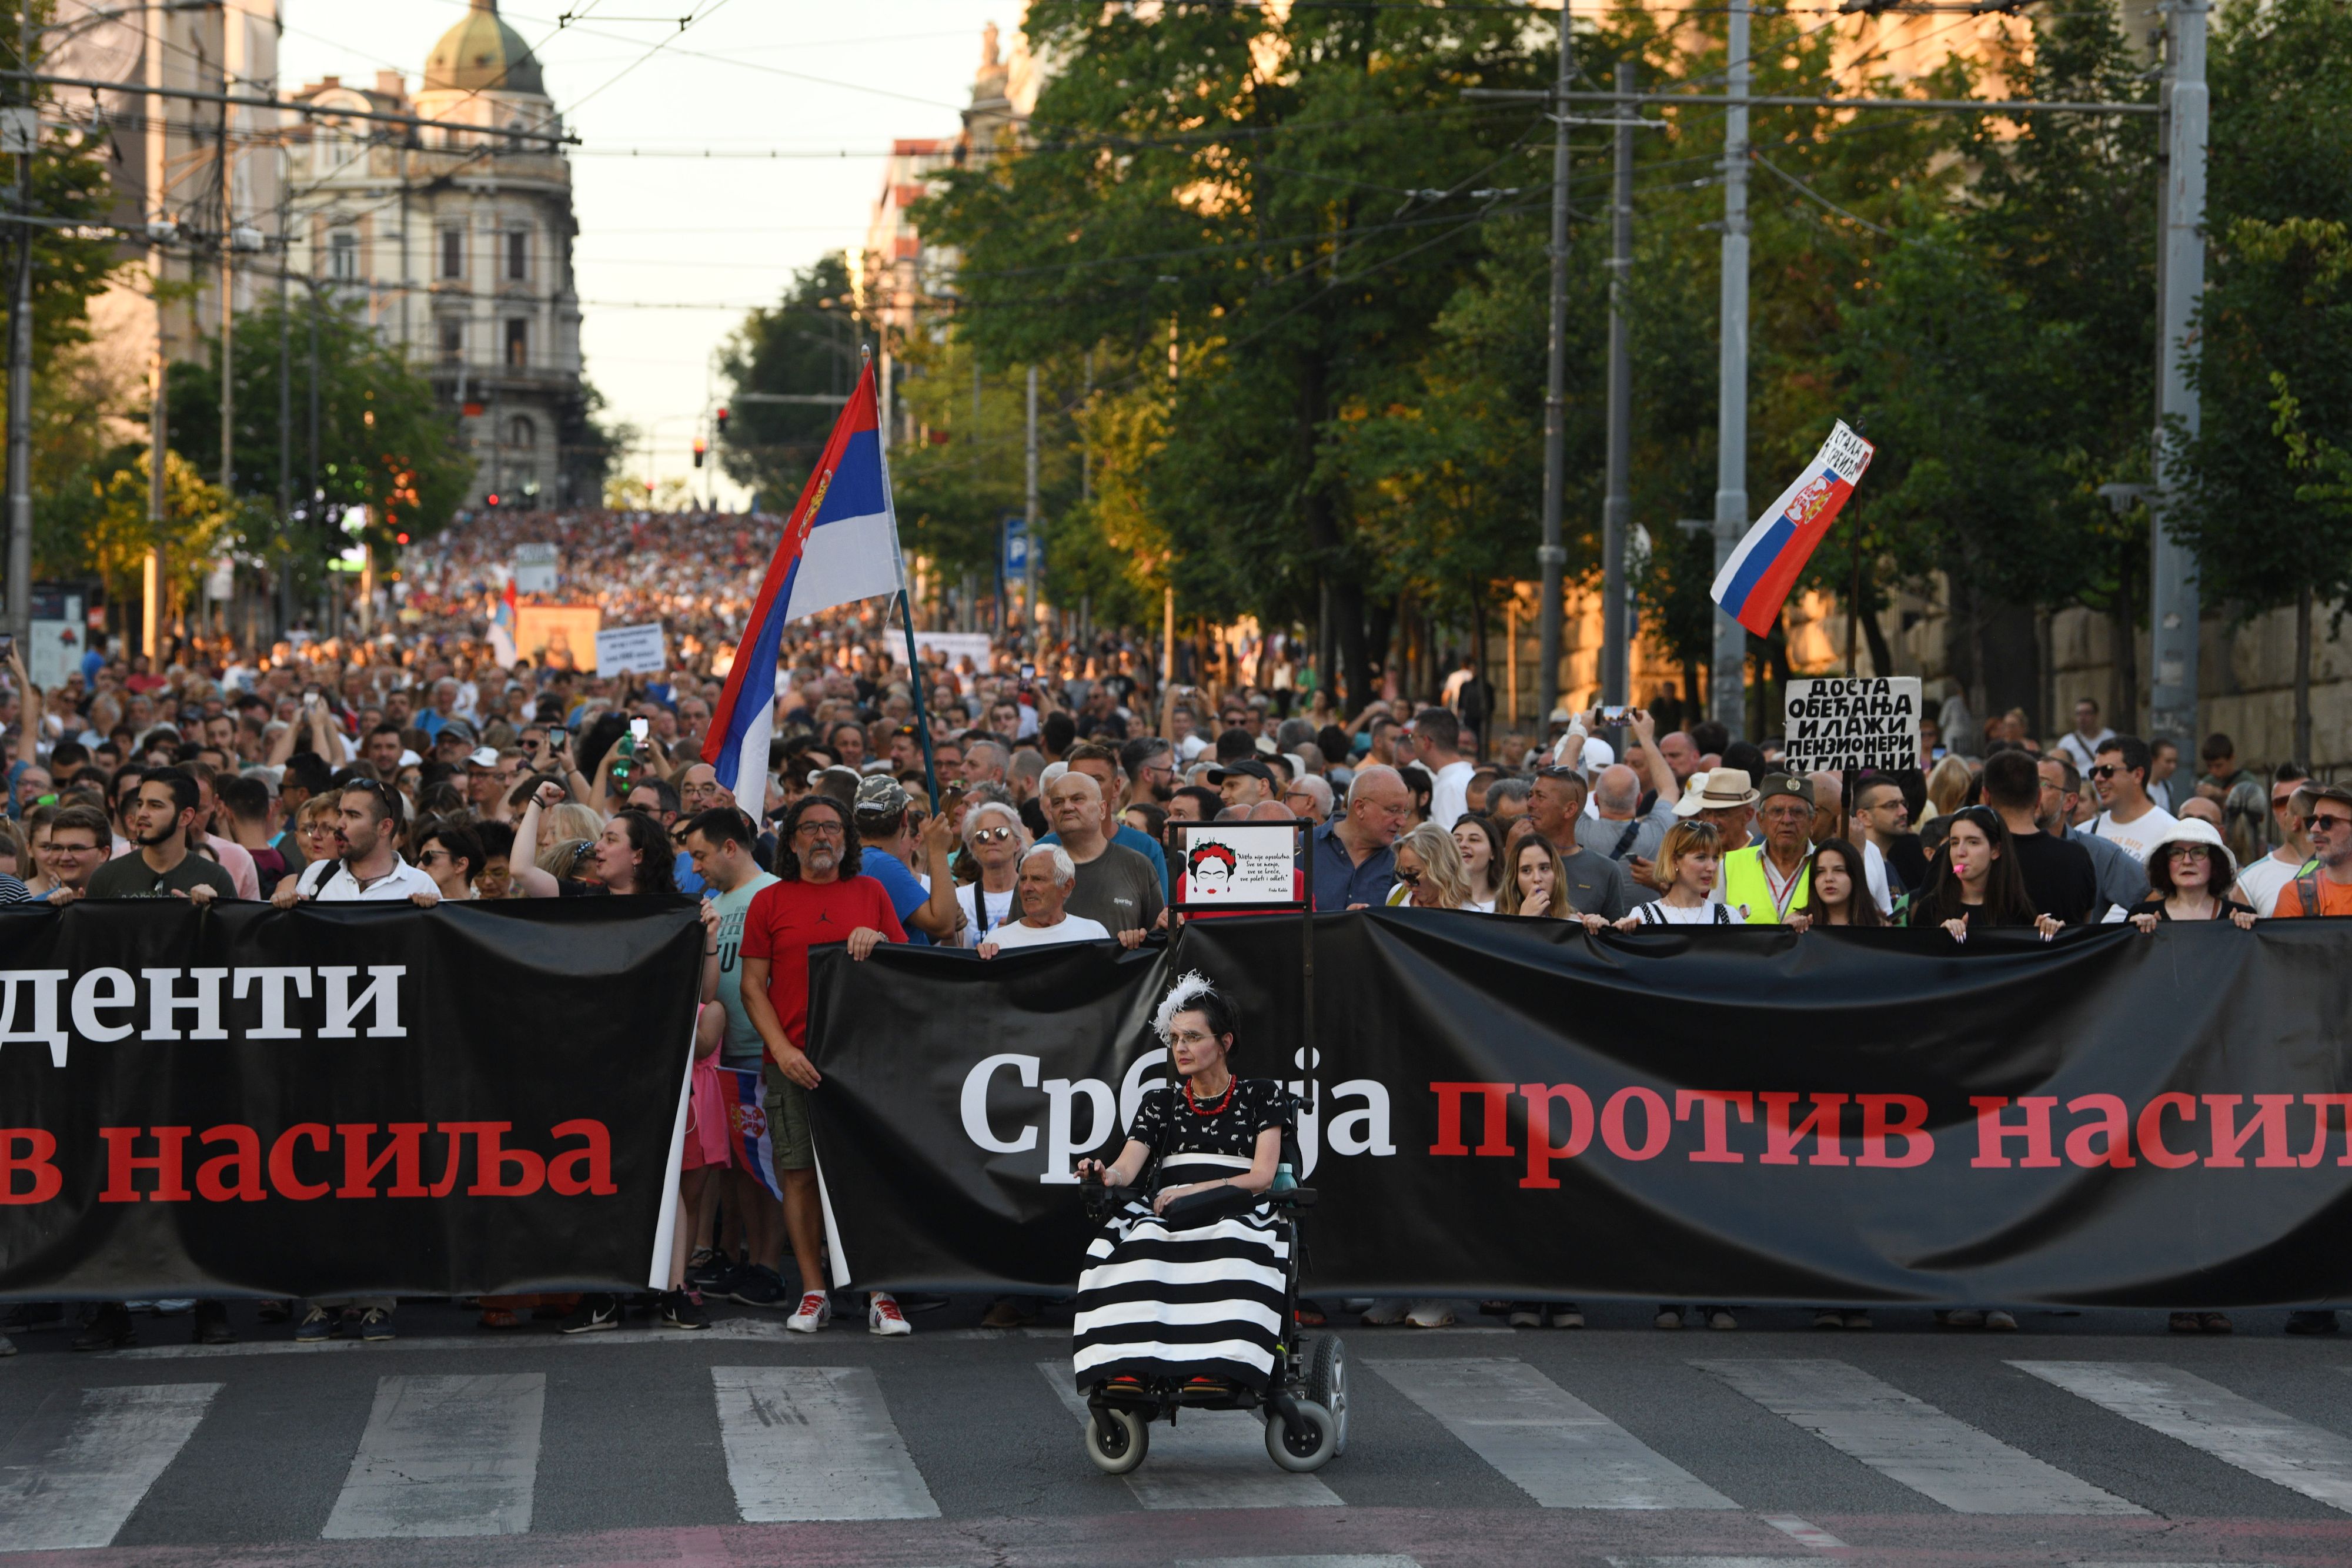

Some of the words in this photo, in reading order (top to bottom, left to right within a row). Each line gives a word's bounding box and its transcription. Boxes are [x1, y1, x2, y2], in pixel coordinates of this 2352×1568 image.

[1809, 678, 1890, 698] ДОСТА
[1789, 694, 1912, 718] ОБЕЋАЊА
[1798, 720, 1819, 738] И
[1821, 717, 1906, 737] ЛАЖИ
[1786, 735, 1913, 757] ПЕНЗИОНЕРИ
[1786, 758, 1809, 770] СУ
[1814, 753, 1915, 771] ГЛАДНИ
[1250, 875, 1264, 883] poleti
[0, 966, 406, 1067] денти
[961, 1047, 1396, 1184] Србја
[1430, 1082, 1934, 1188] против
[0, 1129, 62, 1205] в
[100, 1119, 617, 1202] насиља
